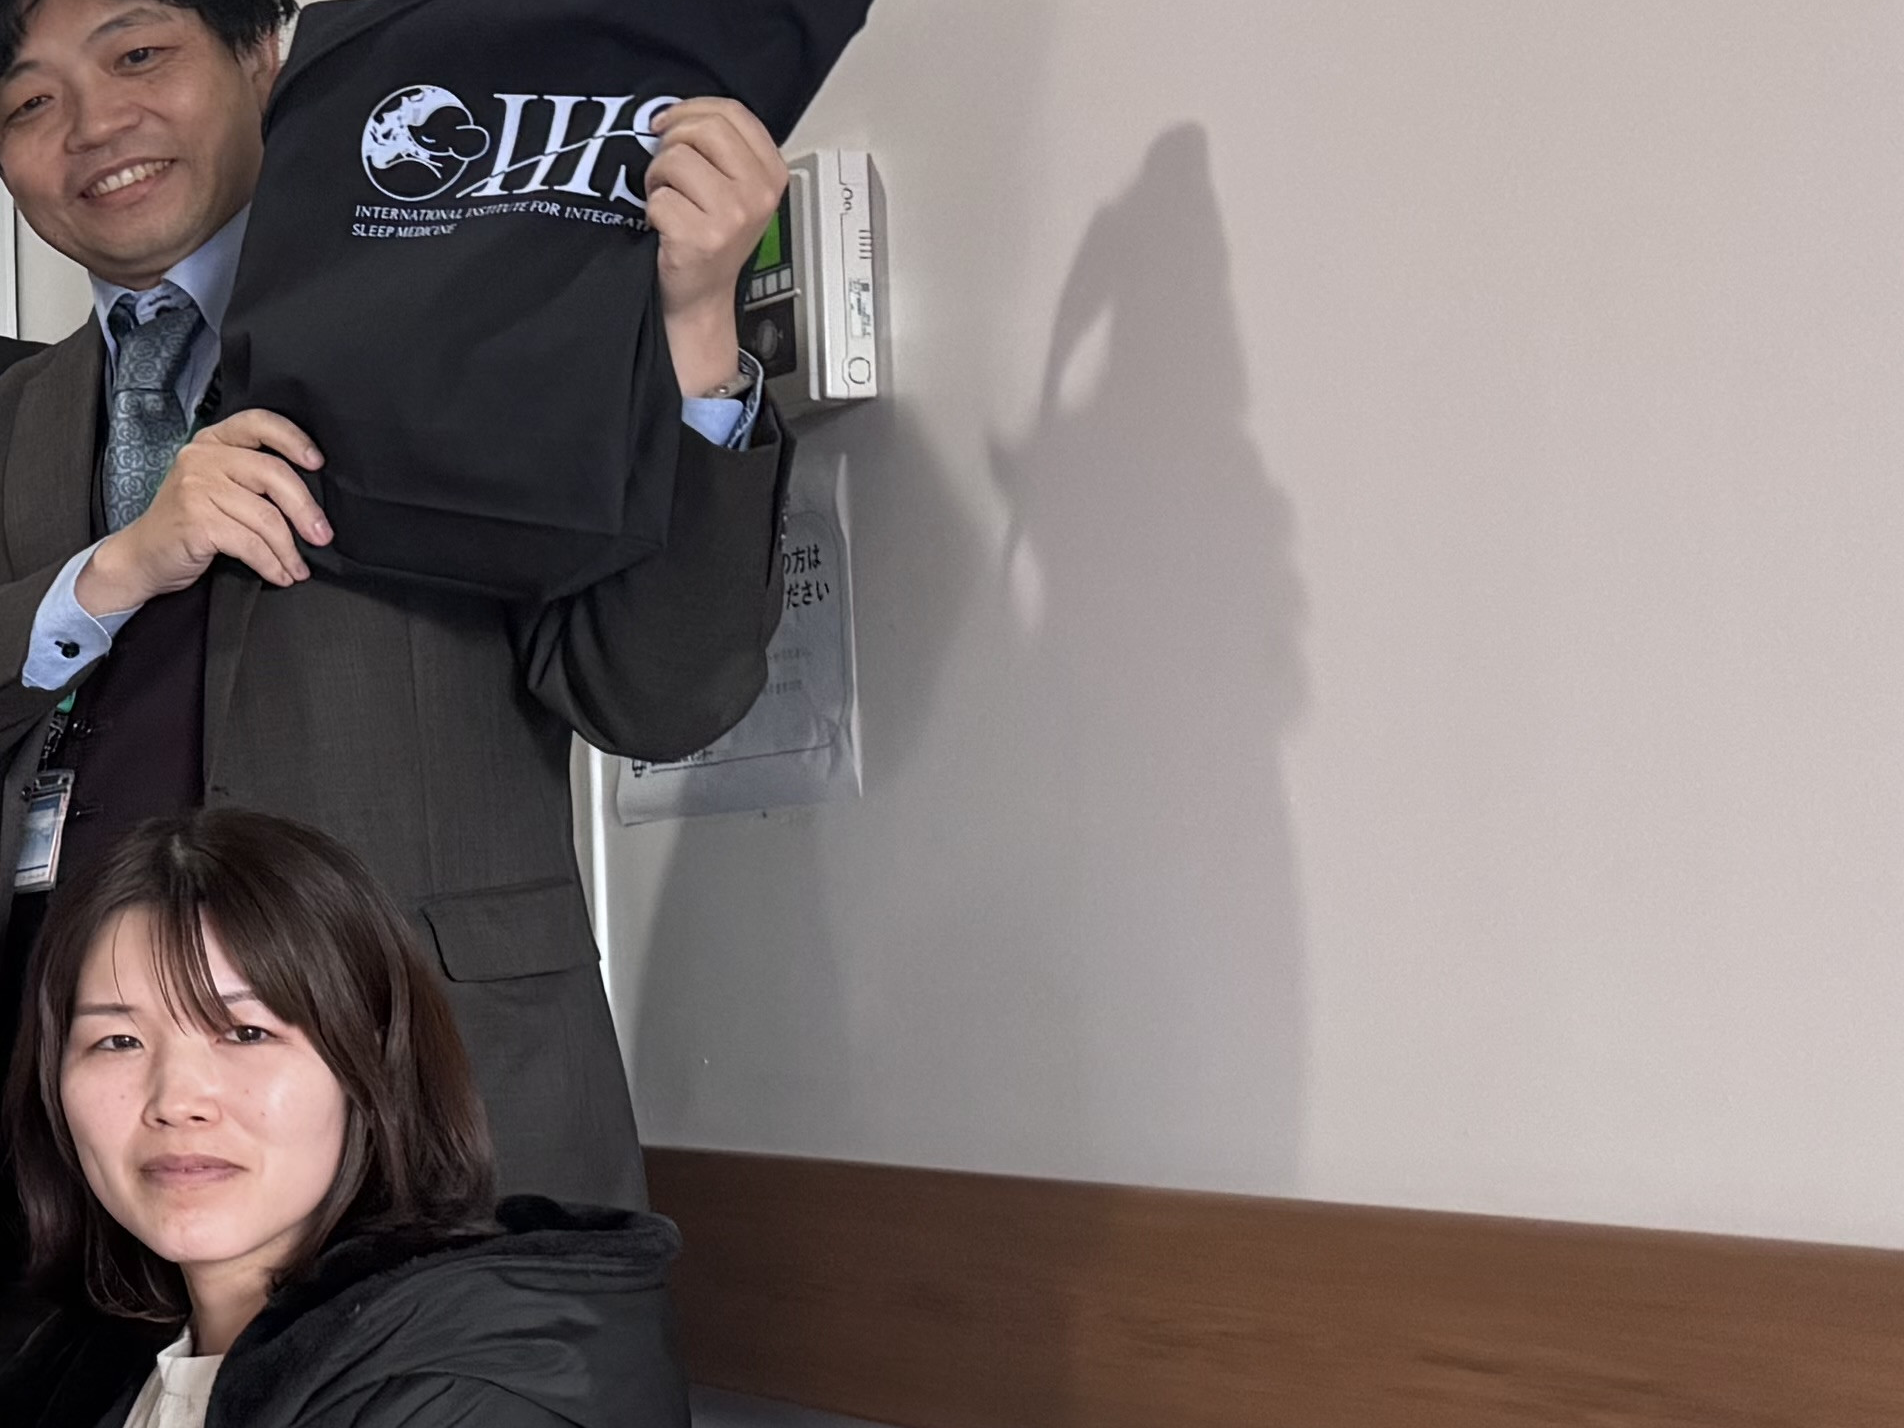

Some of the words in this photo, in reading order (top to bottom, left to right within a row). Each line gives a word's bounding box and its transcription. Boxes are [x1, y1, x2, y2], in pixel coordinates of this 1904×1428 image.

[355, 205, 463, 221] INTERNATIONAL
[529, 200, 561, 217] FOR
[352, 223, 395, 238] SLEEP
